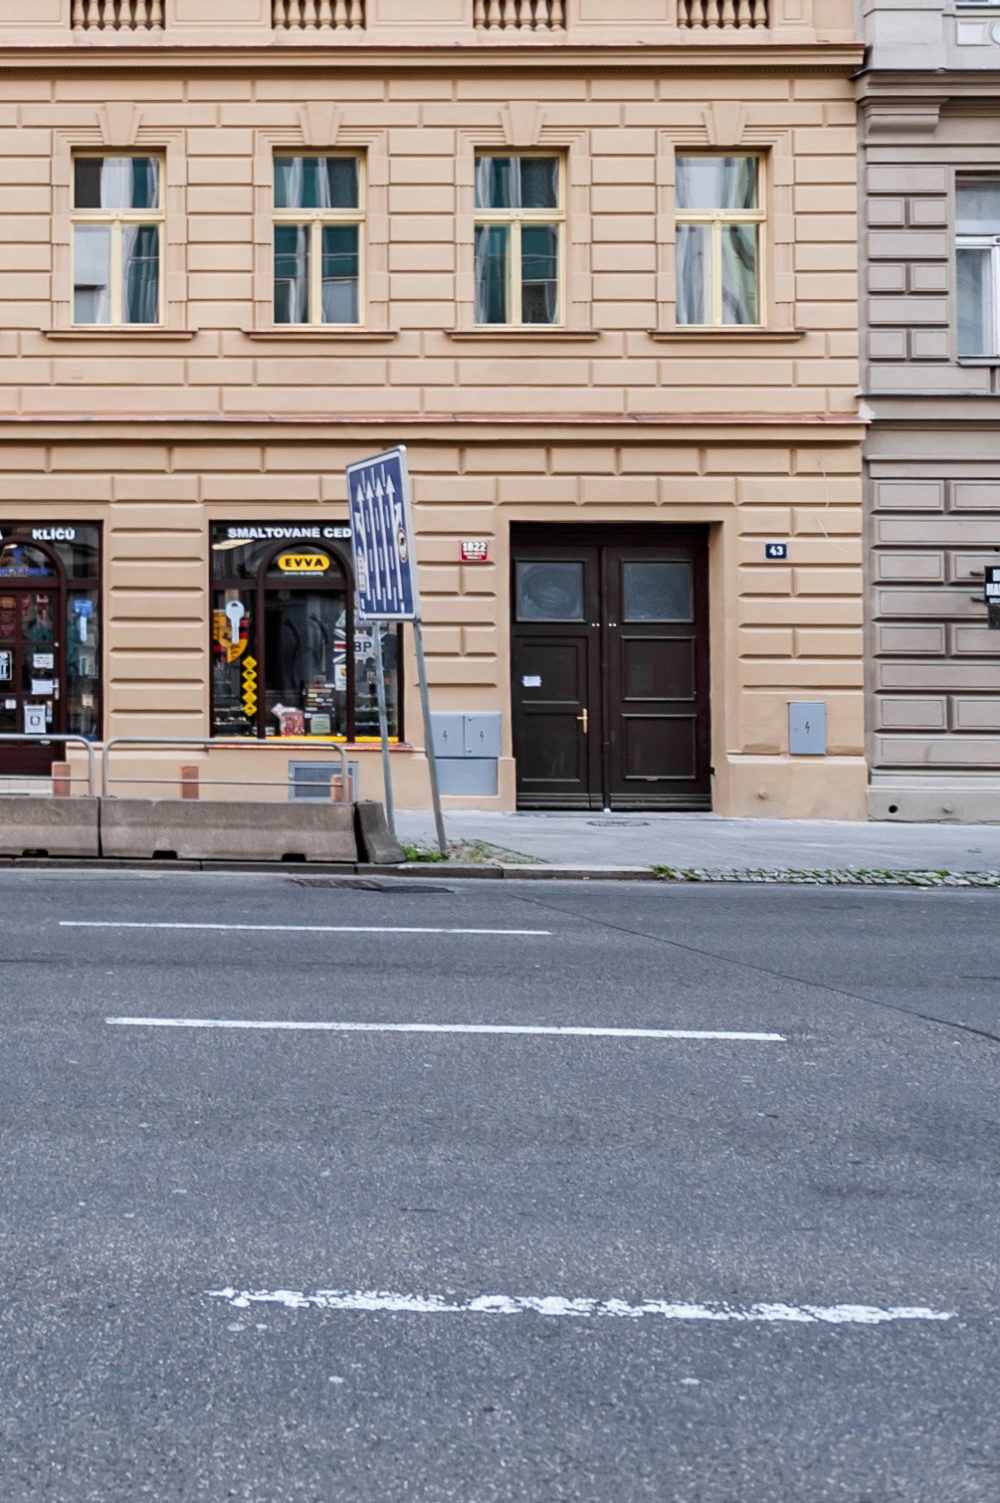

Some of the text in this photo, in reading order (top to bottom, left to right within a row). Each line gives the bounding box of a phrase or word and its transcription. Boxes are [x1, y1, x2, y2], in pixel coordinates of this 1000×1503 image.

[323, 527, 352, 538] CED
[462, 542, 487, 552] 1822
[769, 546, 784, 556] 43
[285, 558, 323, 567] EVVA
